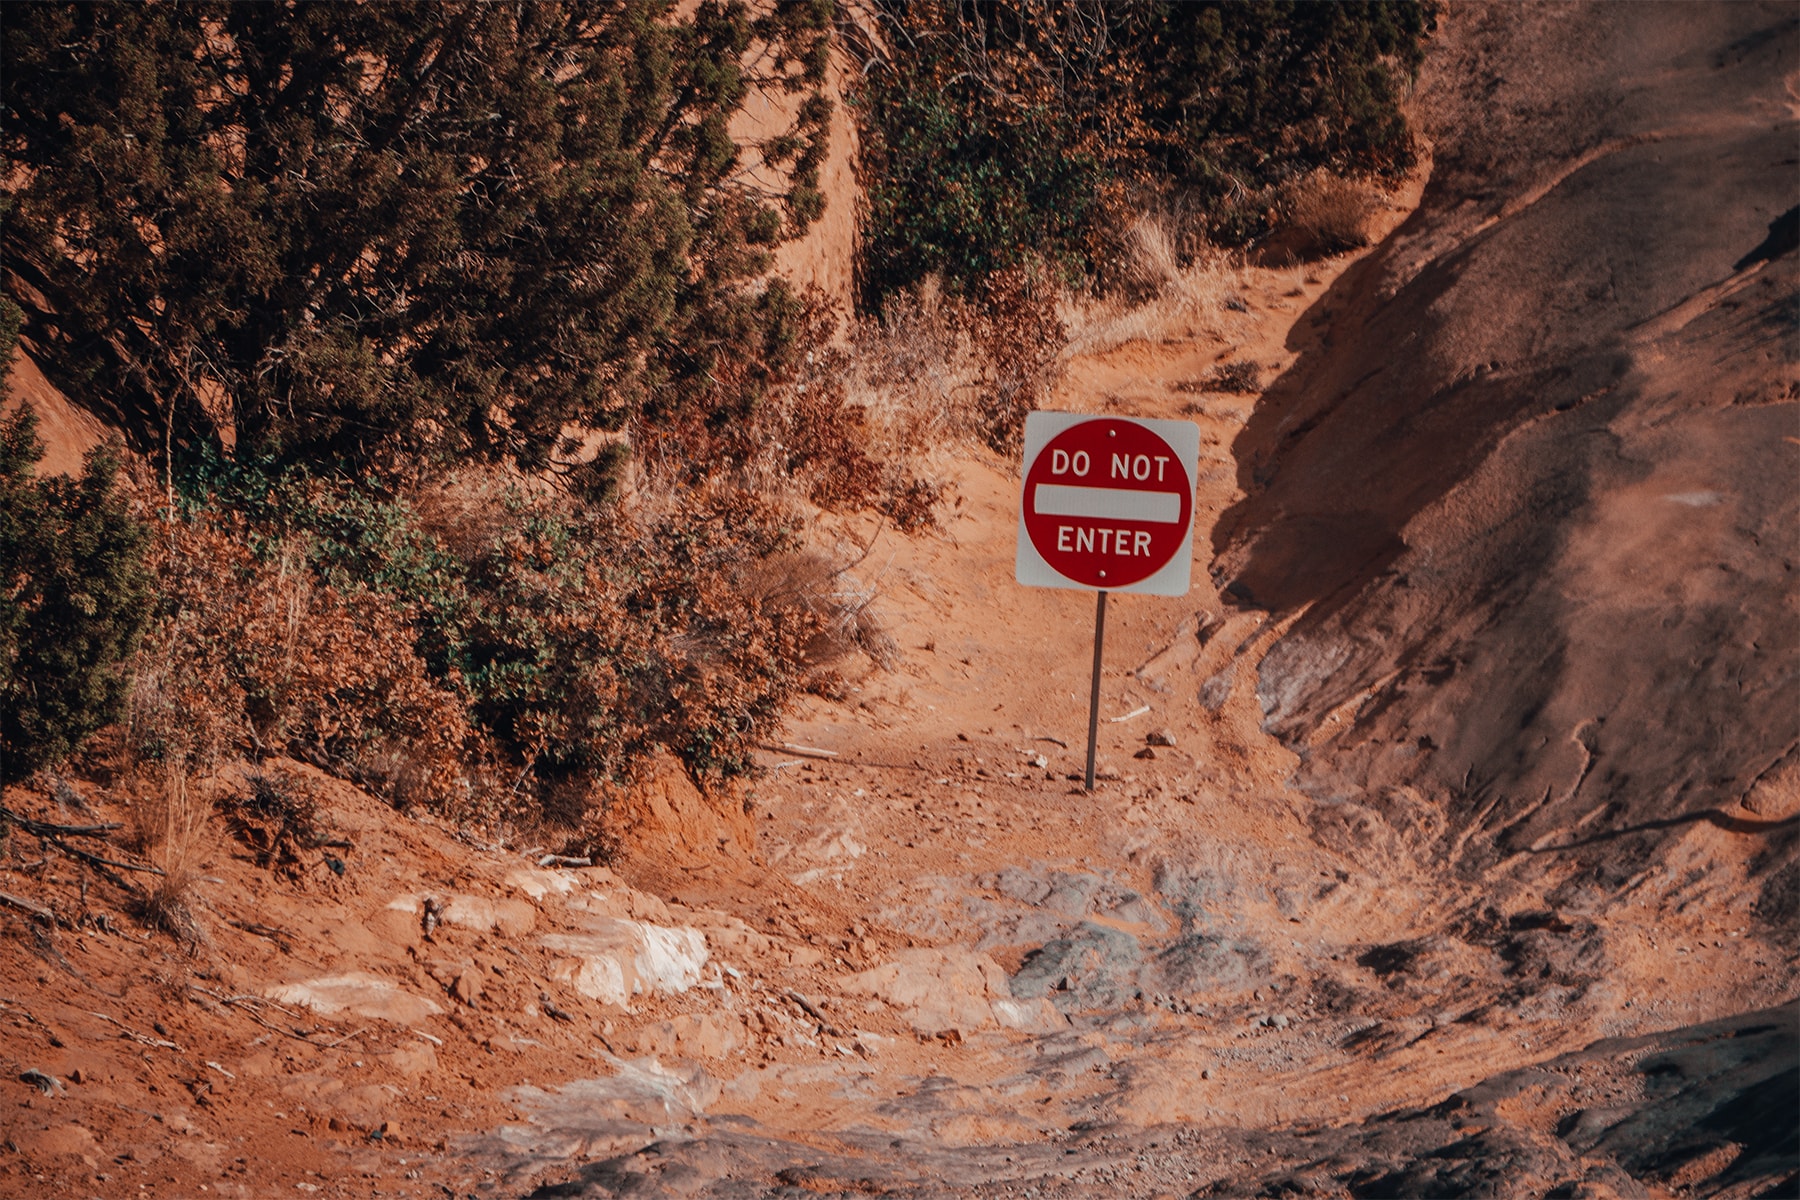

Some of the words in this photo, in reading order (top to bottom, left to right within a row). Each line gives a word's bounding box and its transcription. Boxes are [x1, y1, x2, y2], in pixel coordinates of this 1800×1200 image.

[1052, 449, 1090, 477] DO
[1111, 453, 1170, 482] NOT
[1057, 525, 1152, 557] ENTER
